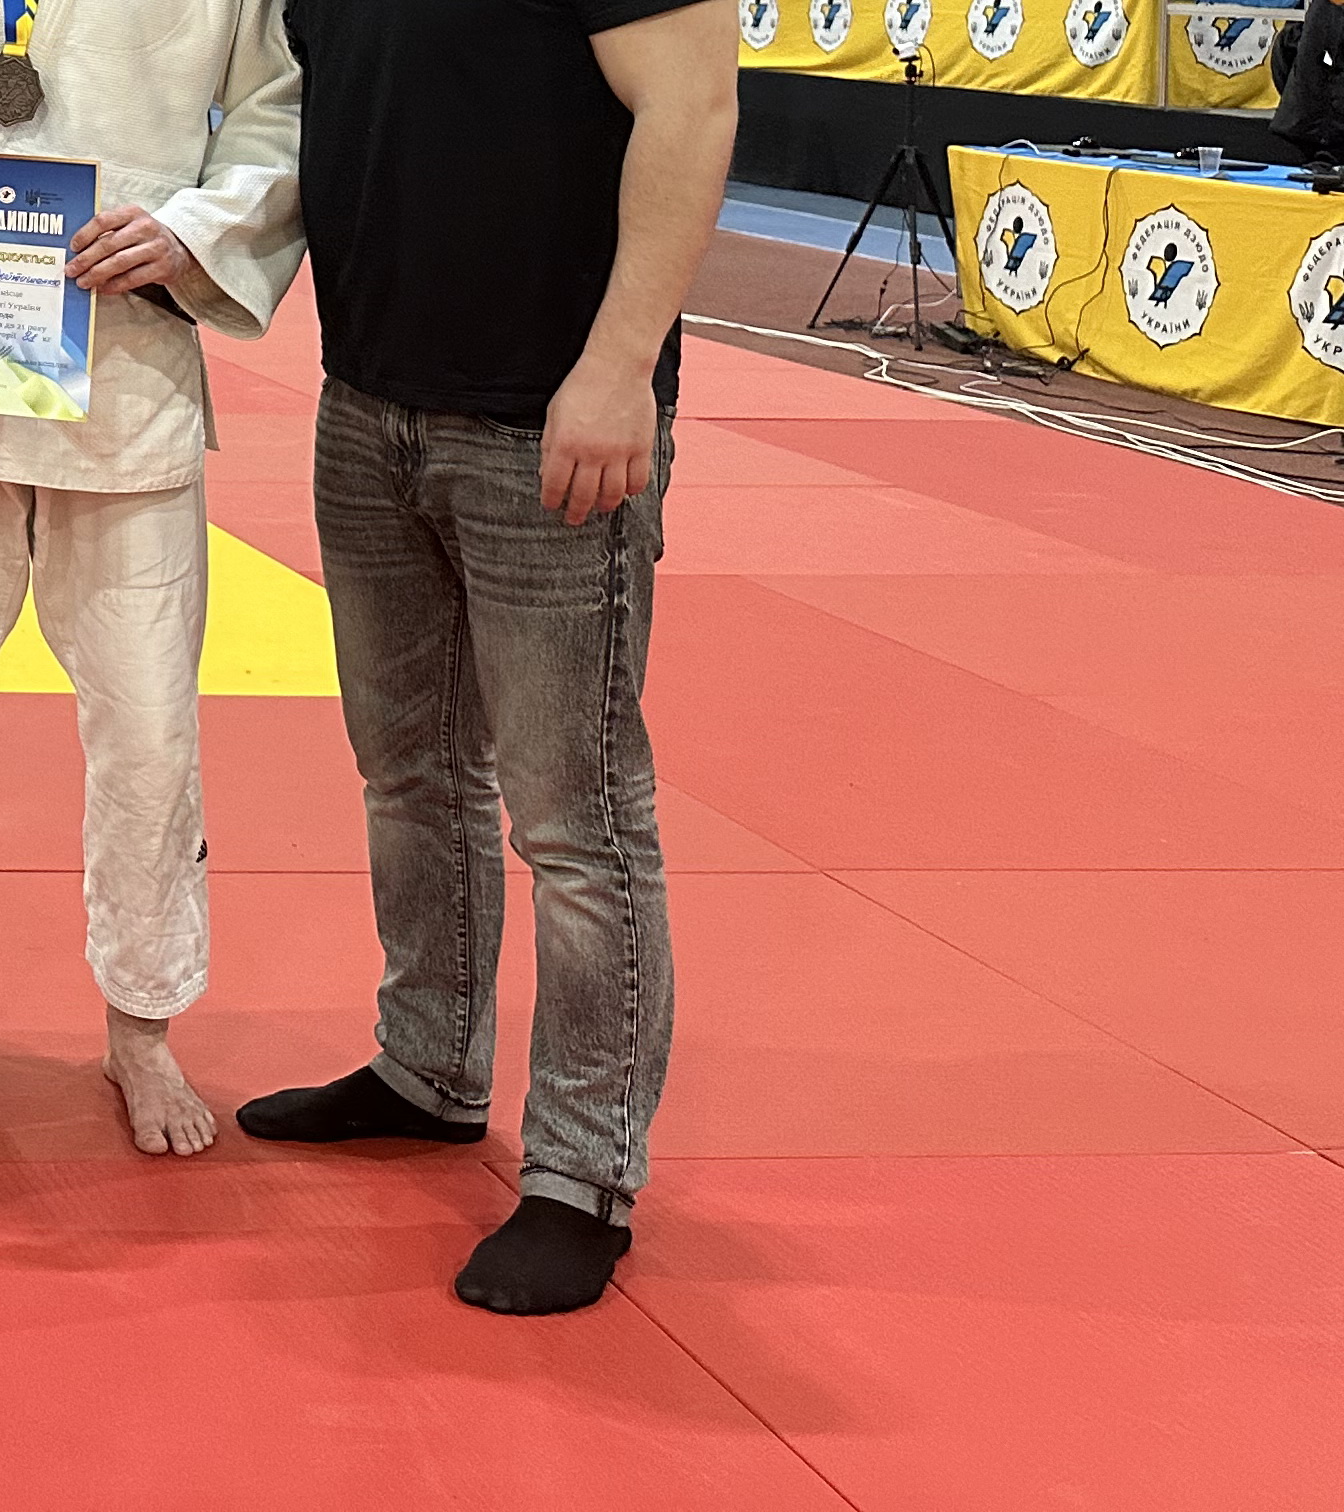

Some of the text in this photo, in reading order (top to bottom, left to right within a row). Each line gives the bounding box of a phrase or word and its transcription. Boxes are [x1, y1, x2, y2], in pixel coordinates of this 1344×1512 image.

[1208, 53, 1254, 68] УКРАЇНИ
[985, 195, 1026, 233] ФЕДРАЦІЯ
[1131, 219, 1209, 273] ФЕДЕРАЦІЯ ДЗЮДО
[1302, 237, 1344, 283] ФЕДЕРА
[996, 277, 1038, 301] УКРАЇНИ
[1141, 310, 1191, 334] УКРАЇНИ
